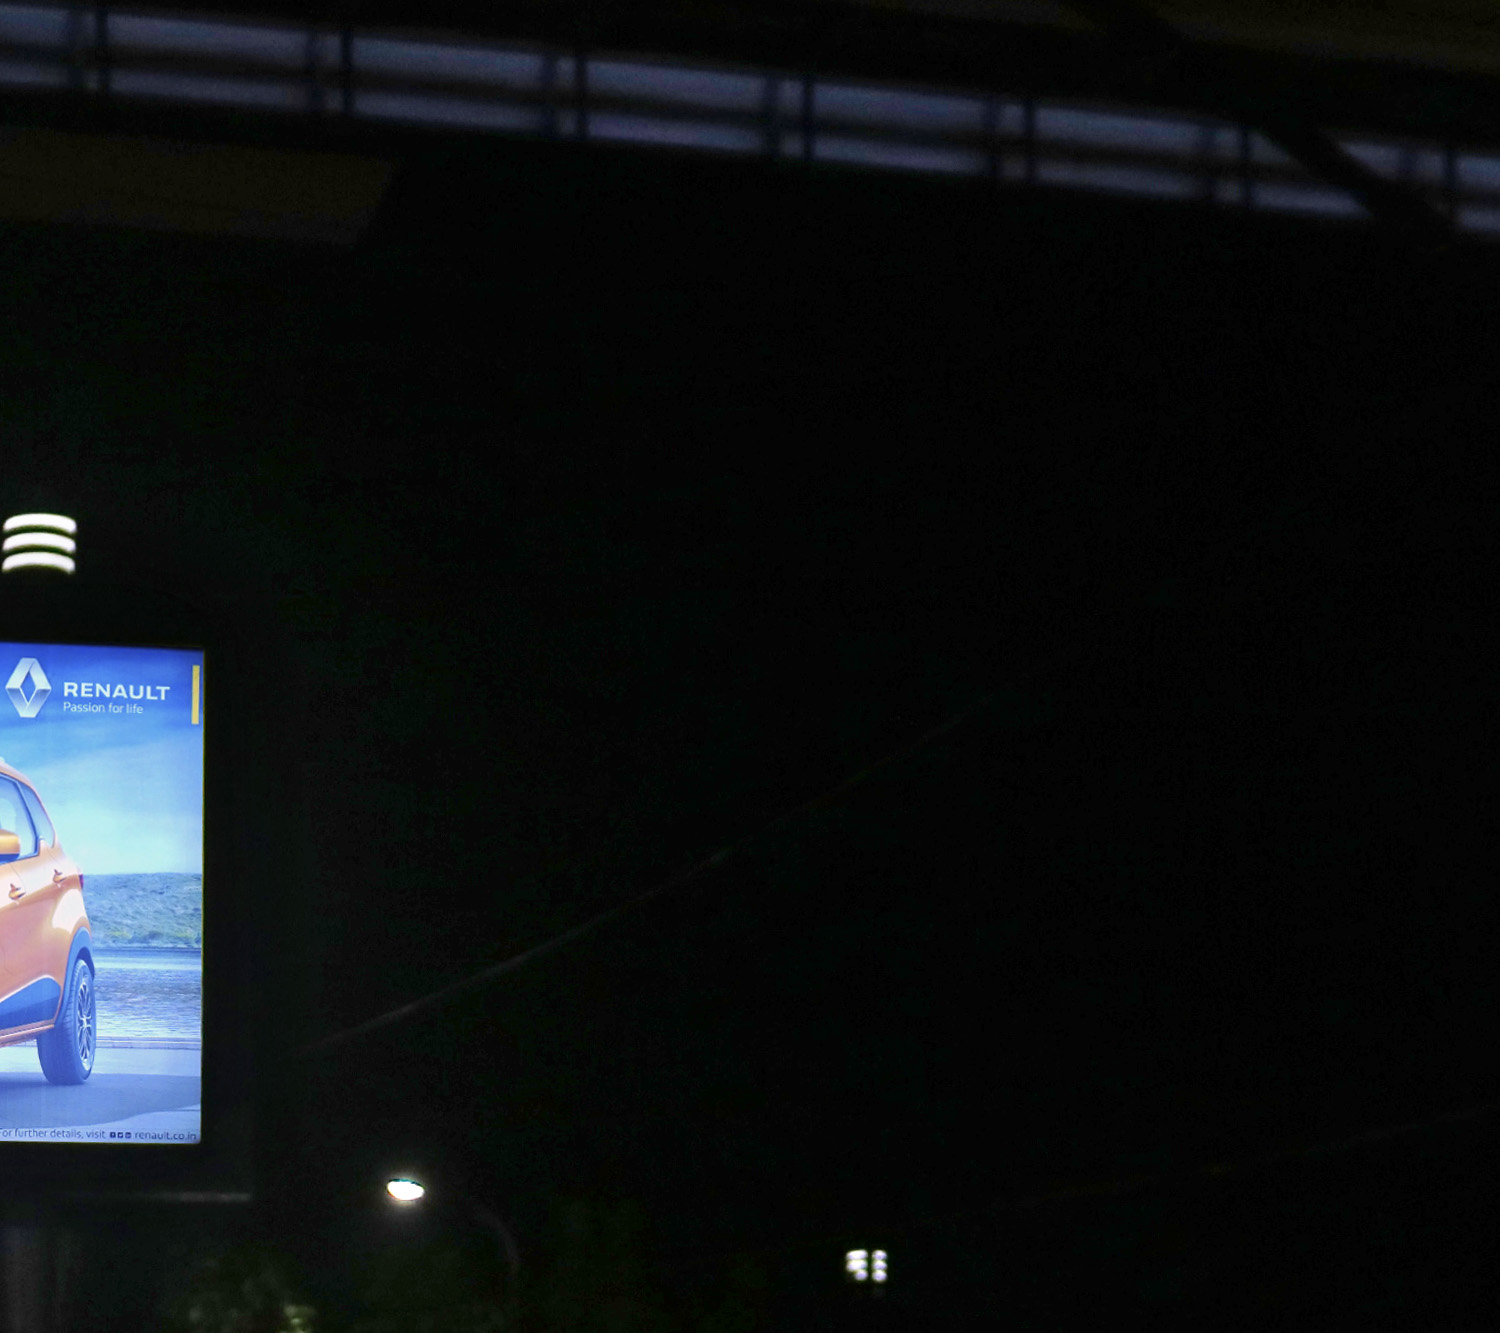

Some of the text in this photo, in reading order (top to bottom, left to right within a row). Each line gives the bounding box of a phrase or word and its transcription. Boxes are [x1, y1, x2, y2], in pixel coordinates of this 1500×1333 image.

[63, 682, 171, 701] RENAULT
[63, 702, 144, 714] Passion for life
[14, 1127, 48, 1138] further
[50, 1128, 84, 1140] details,
[86, 1129, 105, 1139] visit
[135, 1131, 196, 1141] renault.co.in
